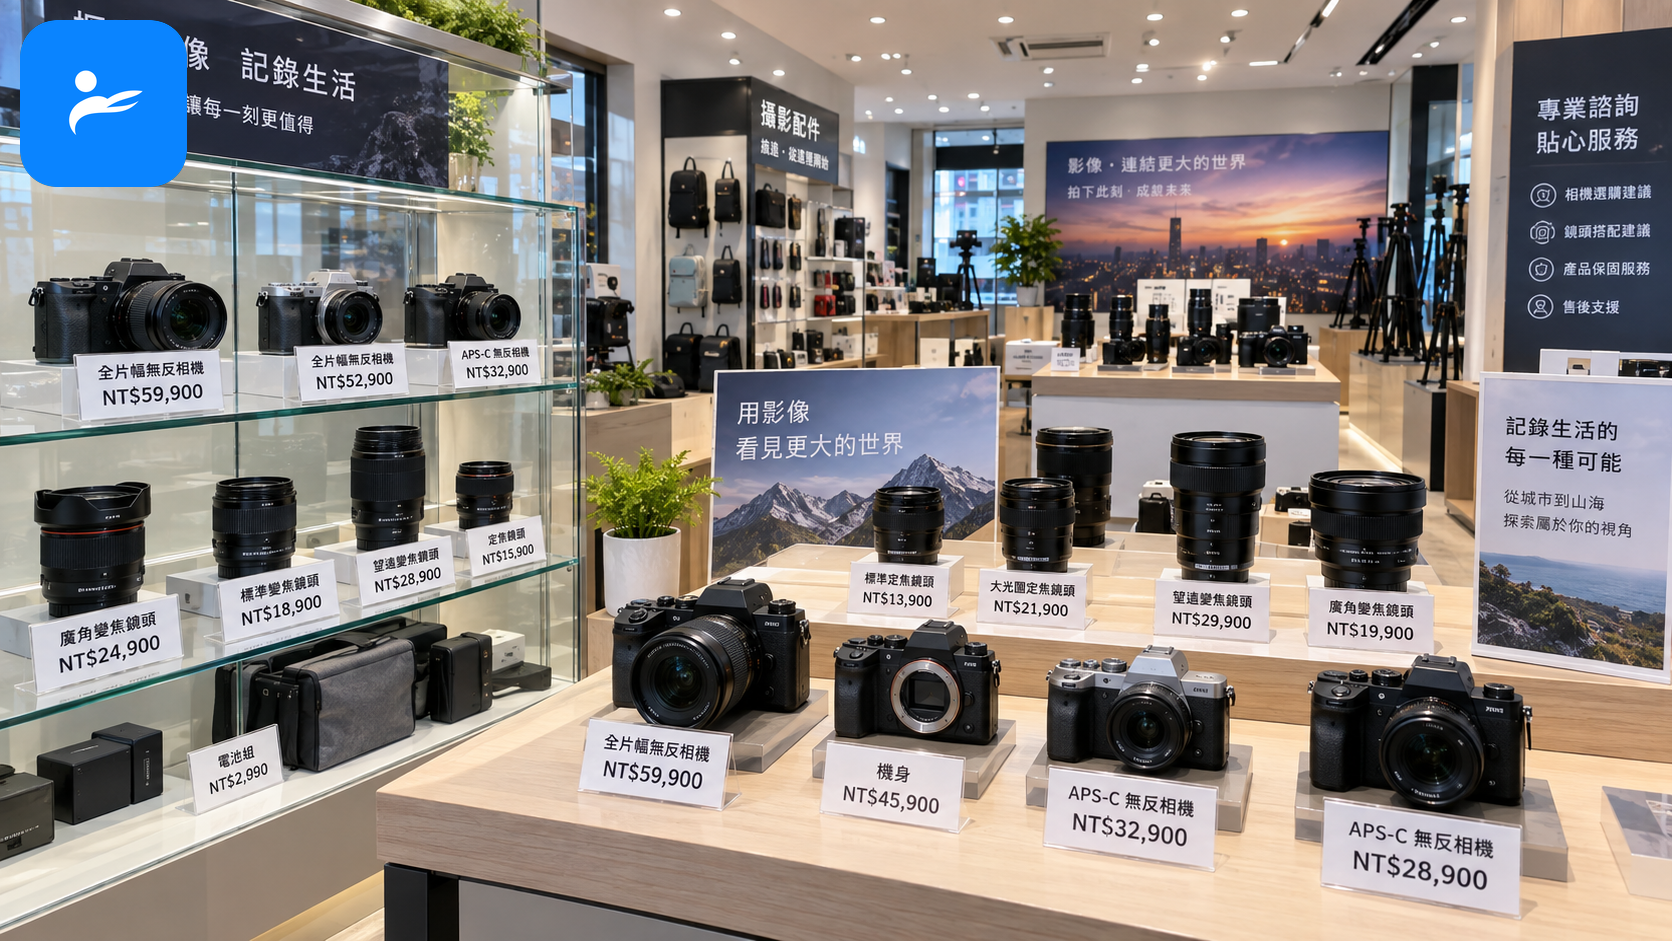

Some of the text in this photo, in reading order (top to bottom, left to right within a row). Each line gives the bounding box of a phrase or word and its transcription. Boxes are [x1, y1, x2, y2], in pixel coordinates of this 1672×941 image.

[240, 47, 356, 102] 記錄生活
[1537, 93, 1639, 122] 專業諮詢
[760, 98, 821, 143] 攝影配件
[1536, 126, 1639, 154] 貼心服務
[1564, 184, 1652, 202] 相機選購建議
[1564, 223, 1651, 239] 鏡頭搭配建議
[1563, 261, 1650, 276] 產品保固服務
[1562, 299, 1620, 315] 售後支援
[311, 352, 394, 369] 全片幅無反相機
[461, 346, 530, 360] APS-C 無反相機
[97, 360, 205, 381] 全片幅無反相機
[316, 371, 393, 390] NT$52,900
[466, 363, 529, 379] NT$32,900
[102, 383, 203, 406] NT$59,900
[737, 399, 810, 425] 用影像
[1505, 415, 1618, 442] 記錄生活的
[735, 432, 904, 462] 看見更大的世界
[1504, 446, 1622, 473] 每一種可能
[1503, 489, 1605, 512] 從城市到山海
[487, 527, 527, 546] 定焦鏡頭
[1503, 512, 1632, 539] 探索屬於你的視角
[482, 543, 535, 566] NT$15,900
[239, 572, 321, 603] 標準變焦鏡頭
[374, 566, 442, 594] NT$28,900
[864, 571, 935, 589] 標準定焦鏡頭
[990, 579, 1076, 598] 大光圈定焦鏡頭
[240, 594, 322, 627] NT$18,900
[862, 591, 933, 608] NT$13,900
[994, 599, 1069, 617] NT$21,900
[1328, 599, 1414, 619] 廣角變焦鏡頭
[59, 610, 158, 648] 廣角變焦鏡頭
[1172, 611, 1252, 630] NT$29,900
[1327, 621, 1414, 641] NT$19,900
[59, 634, 160, 674] NT$24,900
[216, 745, 256, 769] 電池組
[603, 733, 711, 764] 全片幅無反相機
[209, 762, 268, 795] NT$2,990
[602, 759, 704, 790] NT$59,900
[876, 762, 911, 783] 機身
[843, 785, 940, 814] NT$45,900
[1068, 785, 1194, 818] APS-C 無反相機
[1072, 812, 1188, 847] NT$32,900
[1348, 821, 1495, 860] APS-C 無反相機
[1353, 849, 1488, 891] NT$28,900
